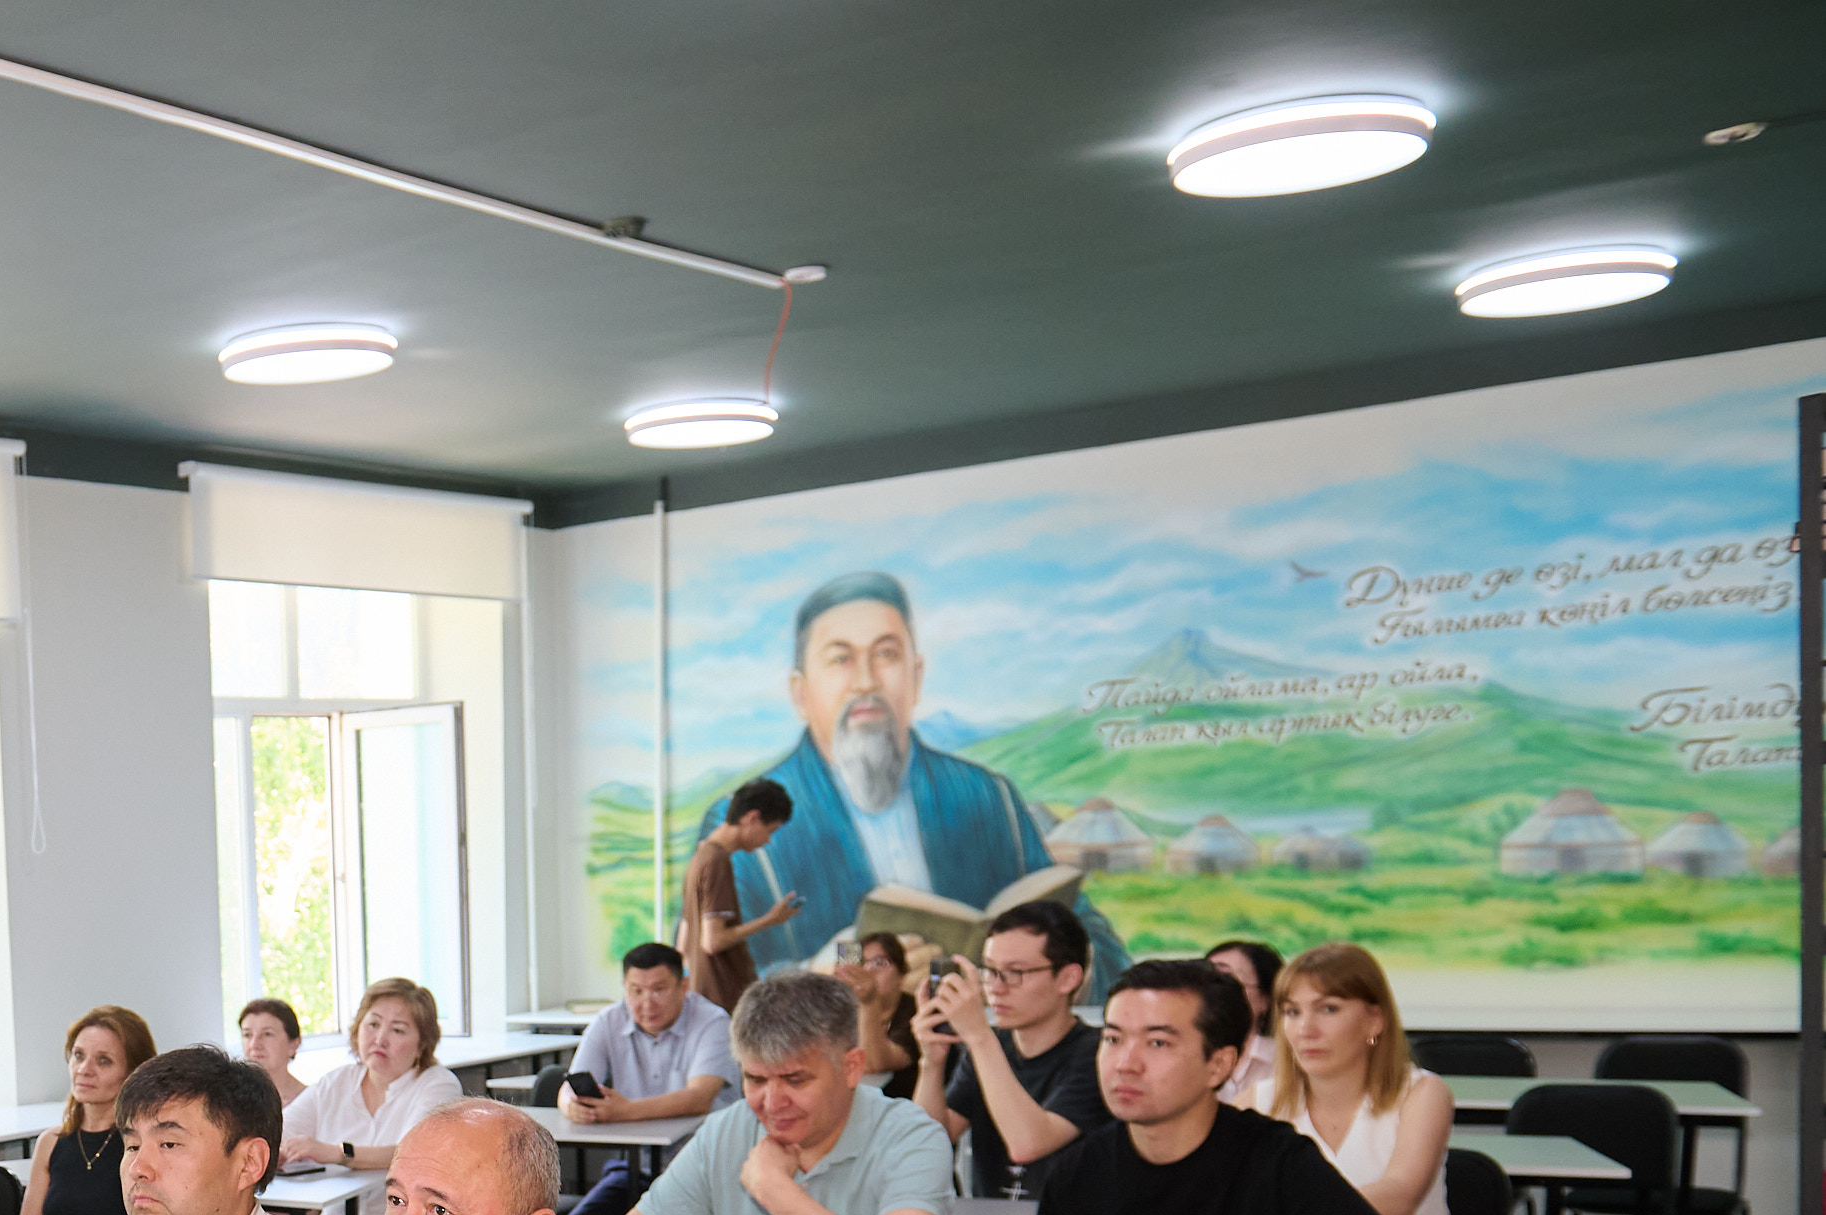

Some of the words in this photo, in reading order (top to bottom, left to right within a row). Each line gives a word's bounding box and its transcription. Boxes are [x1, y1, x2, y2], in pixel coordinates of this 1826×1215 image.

[1473, 565, 1524, 601] де
[1533, 552, 1592, 591] өзі,
[1597, 548, 1686, 579] мал
[1684, 541, 1744, 581] да
[1538, 592, 1631, 628] көңіл
[1336, 672, 1379, 701] ар
